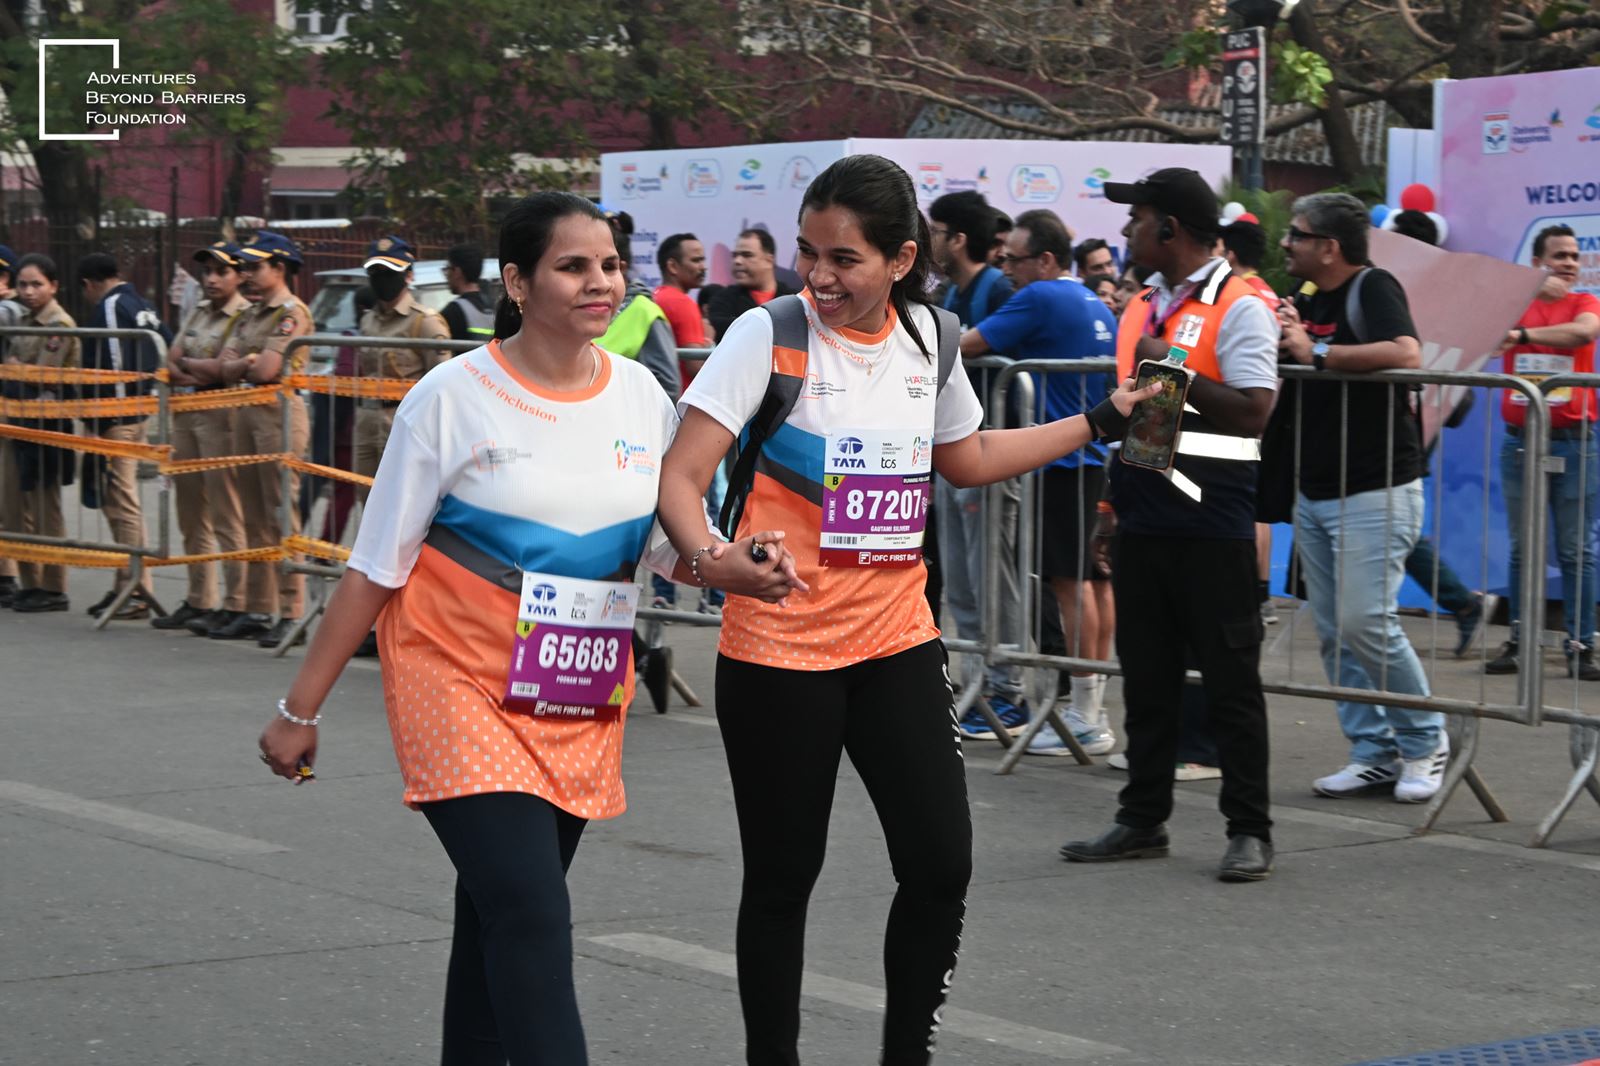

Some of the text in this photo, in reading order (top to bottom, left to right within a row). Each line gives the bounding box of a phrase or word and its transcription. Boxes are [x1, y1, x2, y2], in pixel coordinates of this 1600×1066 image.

[1227, 33, 1251, 48] PUC
[1525, 182, 1600, 205] WELCO
[1577, 237, 1600, 251] TA
[479, 374, 497, 390] for
[496, 387, 557, 423] inclusion
[832, 458, 866, 469] TATA
[881, 457, 897, 469] tcs
[832, 476, 839, 485] B
[846, 489, 922, 520] 87207
[872, 554, 889, 562] IDFC
[889, 553, 907, 561] FIRST
[526, 603, 557, 617] TATA
[538, 632, 619, 673] 65683
[556, 674, 578, 685] POONAM
[546, 704, 595, 716] IDFC FIRST Bank
